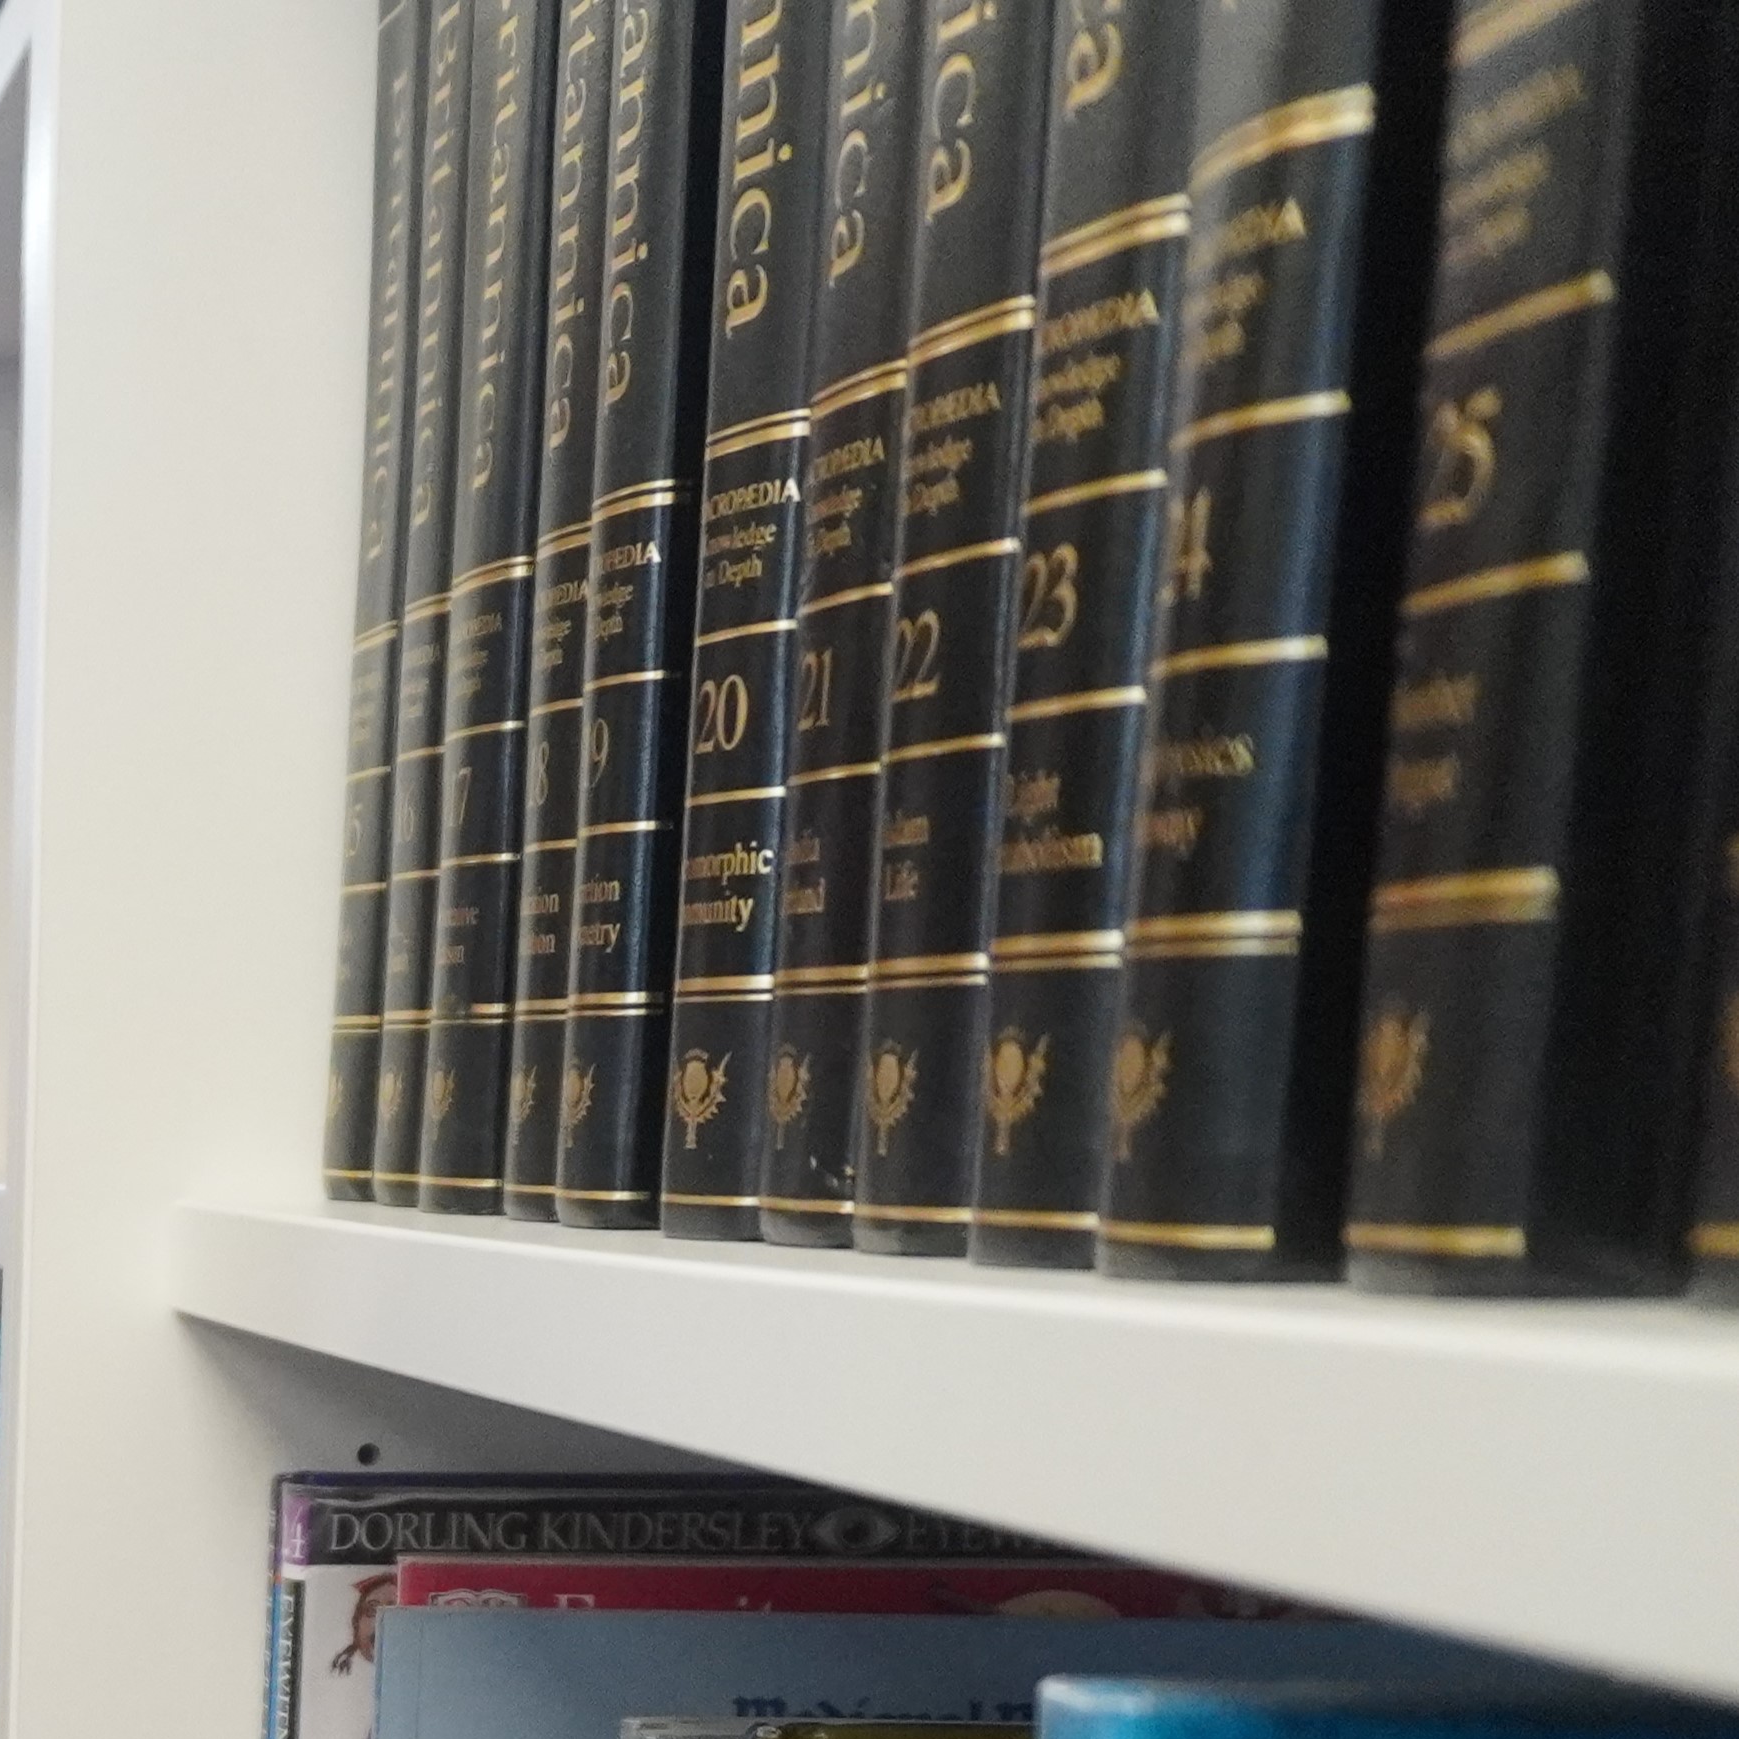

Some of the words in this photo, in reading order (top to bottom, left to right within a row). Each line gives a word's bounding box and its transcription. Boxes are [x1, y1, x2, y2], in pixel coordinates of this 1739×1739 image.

[470, 0, 522, 492] ritannica
[1019, 542, 1079, 650] 23
[797, 649, 833, 731] 21
[895, 611, 940, 702] 22
[694, 674, 749, 754] 20
[329, 1512, 529, 1551] DORLING
[539, 1511, 815, 1551] KINDERSLEY
